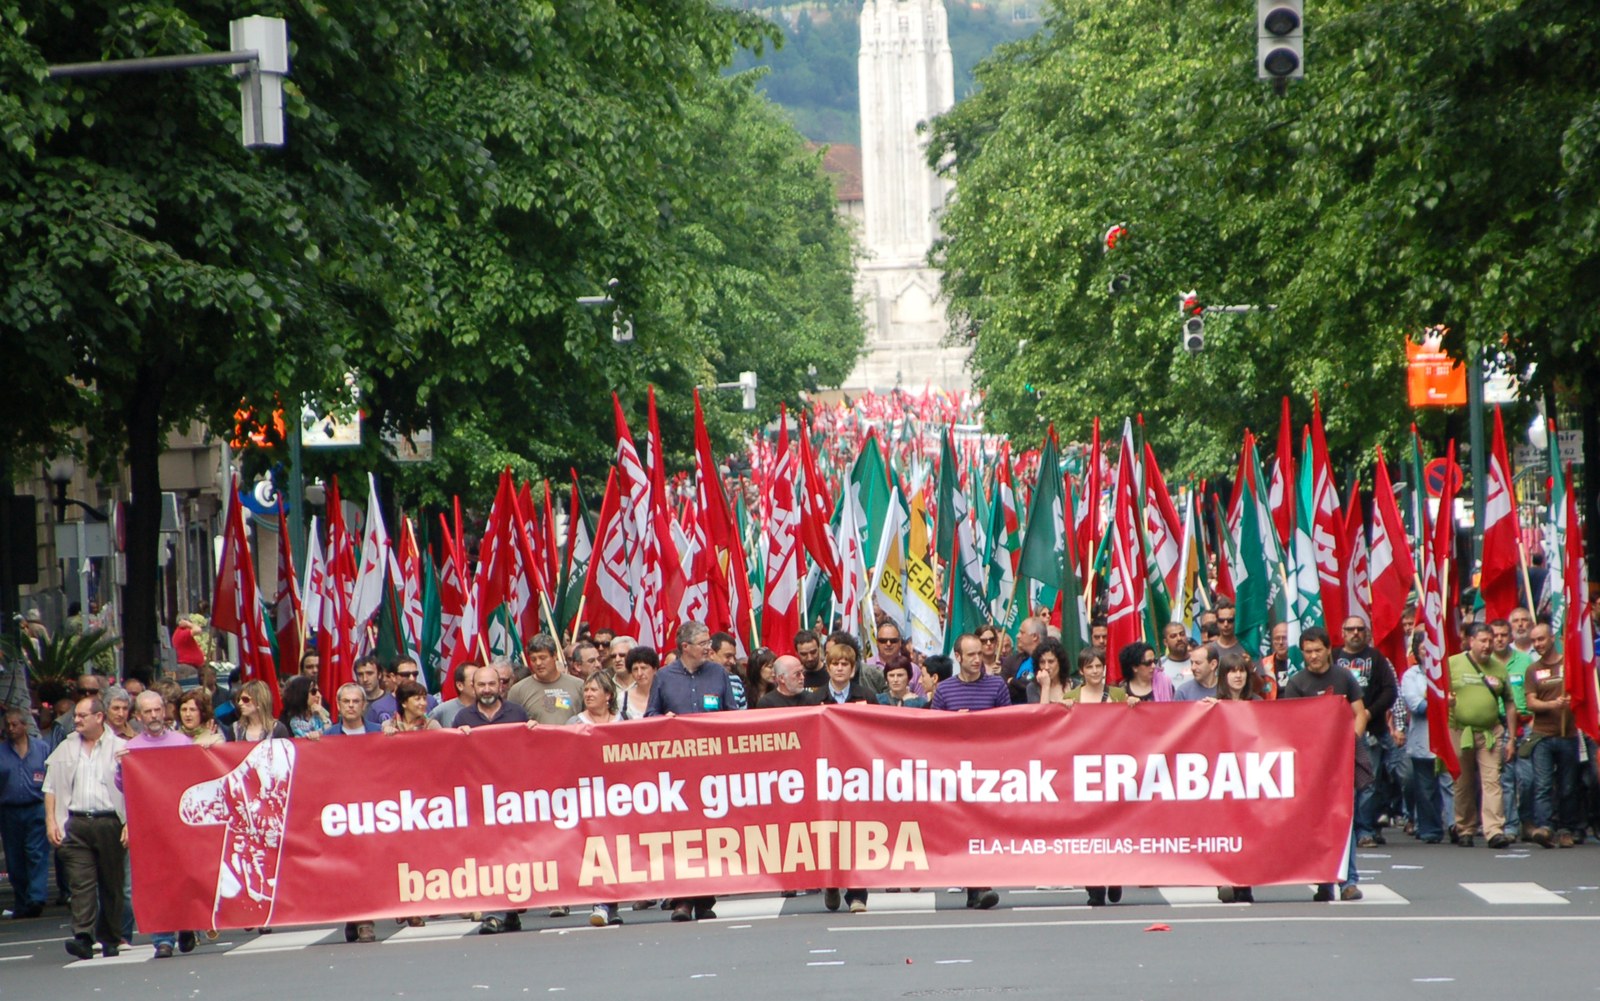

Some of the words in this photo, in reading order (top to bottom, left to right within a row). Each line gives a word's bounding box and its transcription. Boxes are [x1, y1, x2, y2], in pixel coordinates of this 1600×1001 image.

[602, 737, 722, 763] MAIATZAREN
[727, 731, 801, 755] LEHENA
[321, 786, 468, 837] euskal
[483, 771, 689, 829] langileok
[700, 767, 805, 818] gure
[815, 757, 1059, 803] baldintzak
[1072, 751, 1296, 802] ERABAKI
[397, 858, 559, 903] badugu
[578, 820, 930, 887] ALTERNATIBA
